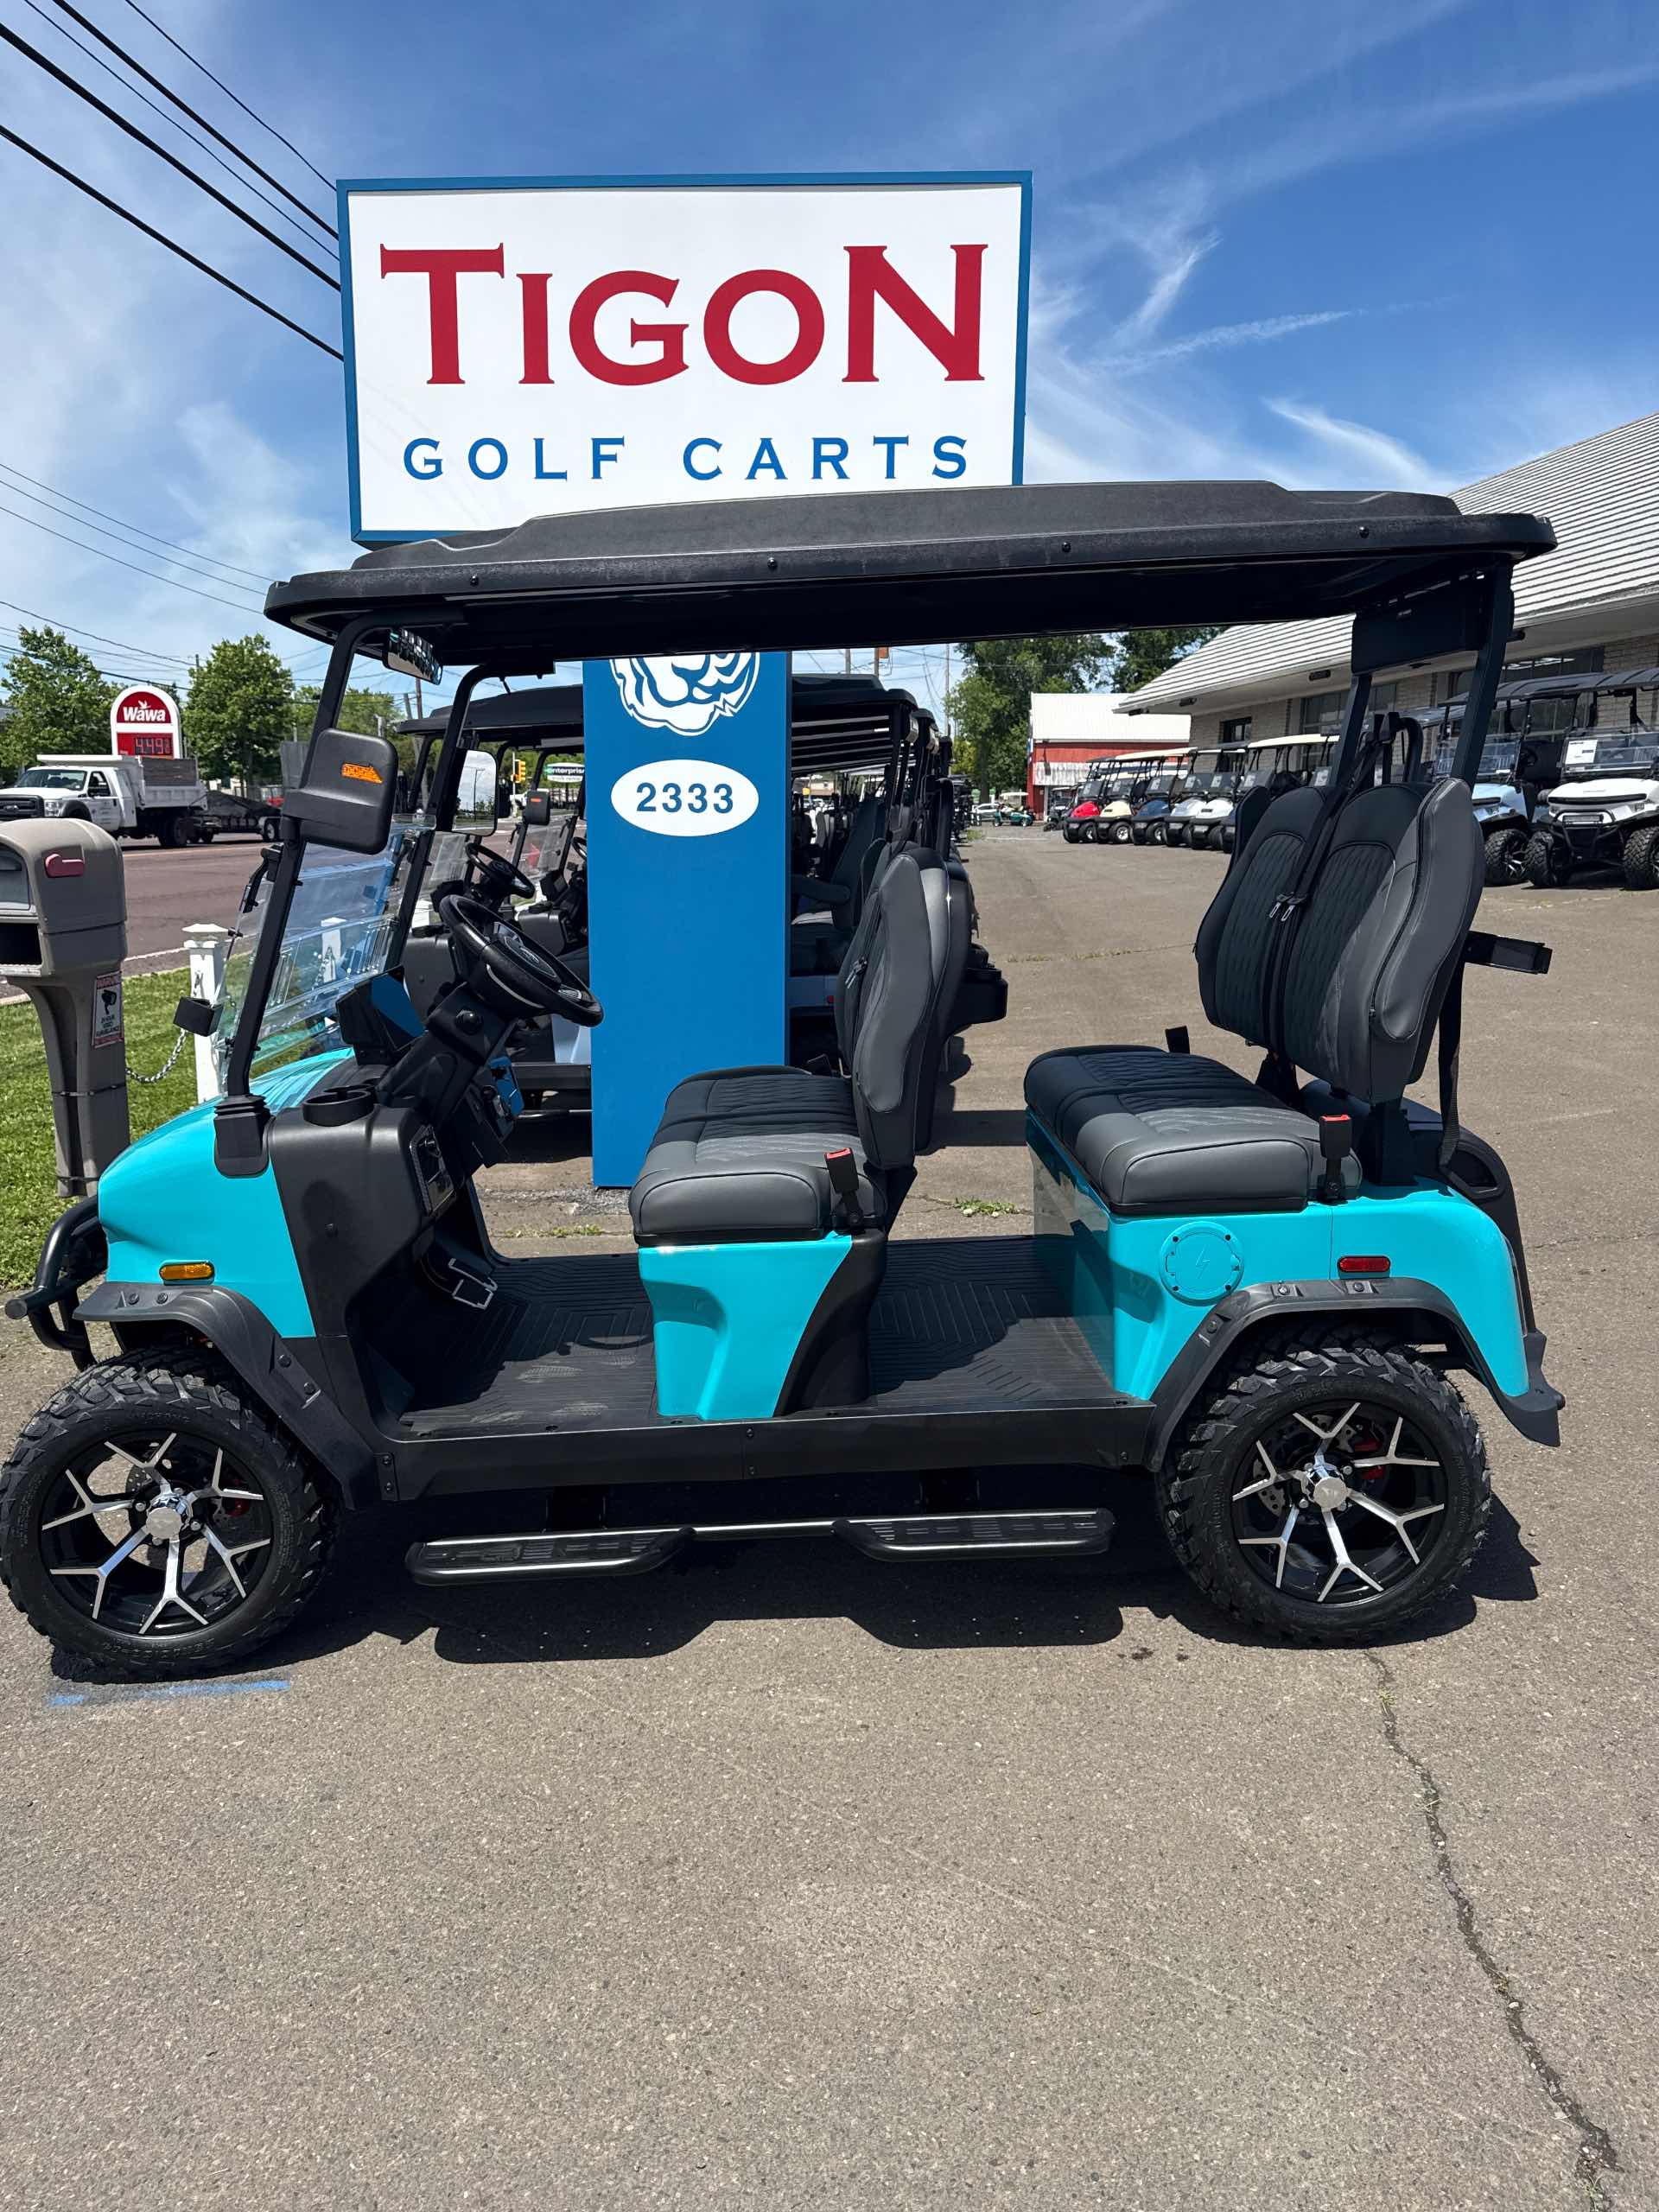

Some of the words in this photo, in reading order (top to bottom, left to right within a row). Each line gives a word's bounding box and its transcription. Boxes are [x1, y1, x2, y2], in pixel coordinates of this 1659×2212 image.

[381, 245, 986, 385] TIGON
[404, 438, 624, 480] GOLF
[683, 435, 965, 480] CARTS
[123, 706, 166, 721] Wawa
[637, 783, 733, 813] 2333
